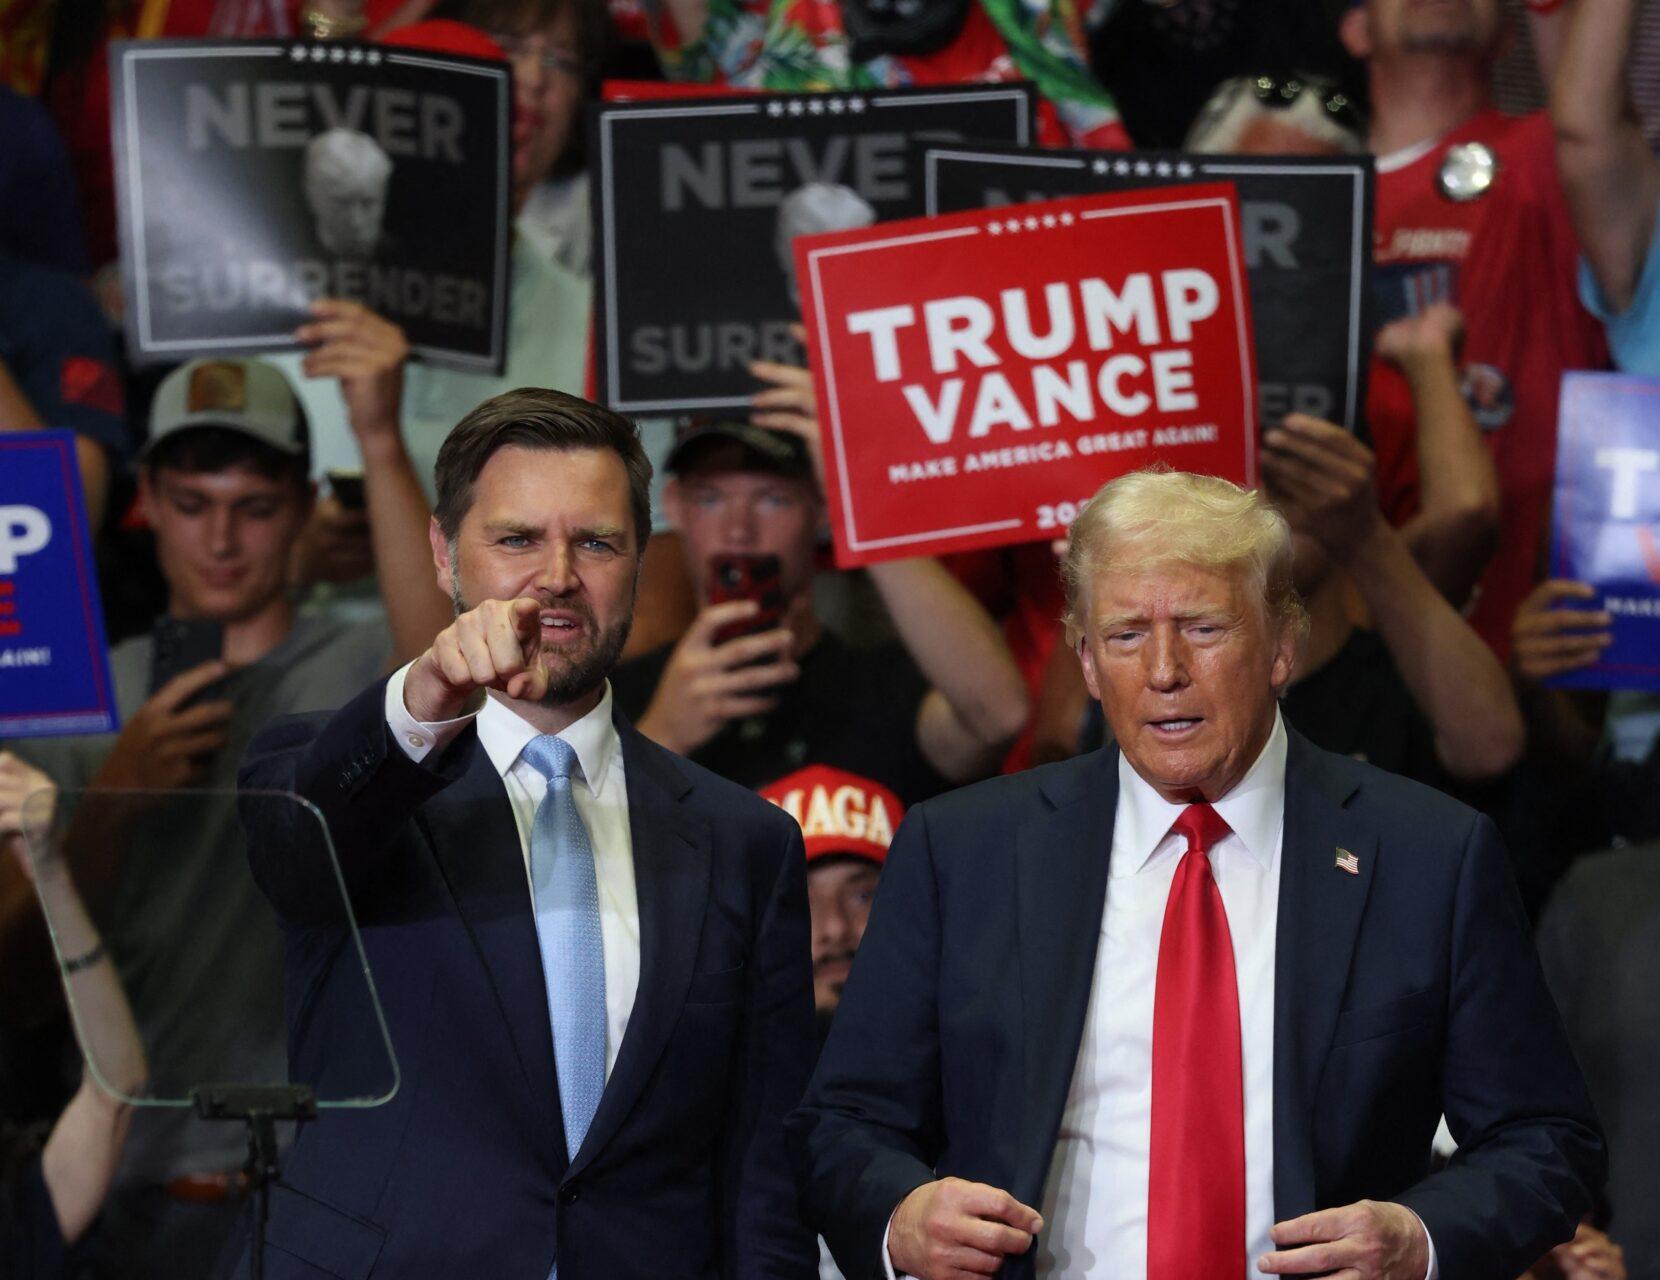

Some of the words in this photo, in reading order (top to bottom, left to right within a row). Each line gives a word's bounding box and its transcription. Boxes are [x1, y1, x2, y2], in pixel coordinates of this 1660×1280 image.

[186, 81, 467, 163] NEVER
[659, 131, 963, 211] NEVE
[161, 257, 488, 328] SURRENDER
[846, 268, 1220, 383] TRUMP
[902, 349, 1200, 444] VANCE
[888, 456, 958, 484] MAKE
[963, 440, 1074, 473] AMERICA
[1076, 428, 1149, 456] GREAT
[1152, 423, 1220, 447] AGAIN!
[1036, 499, 1094, 531] 20
